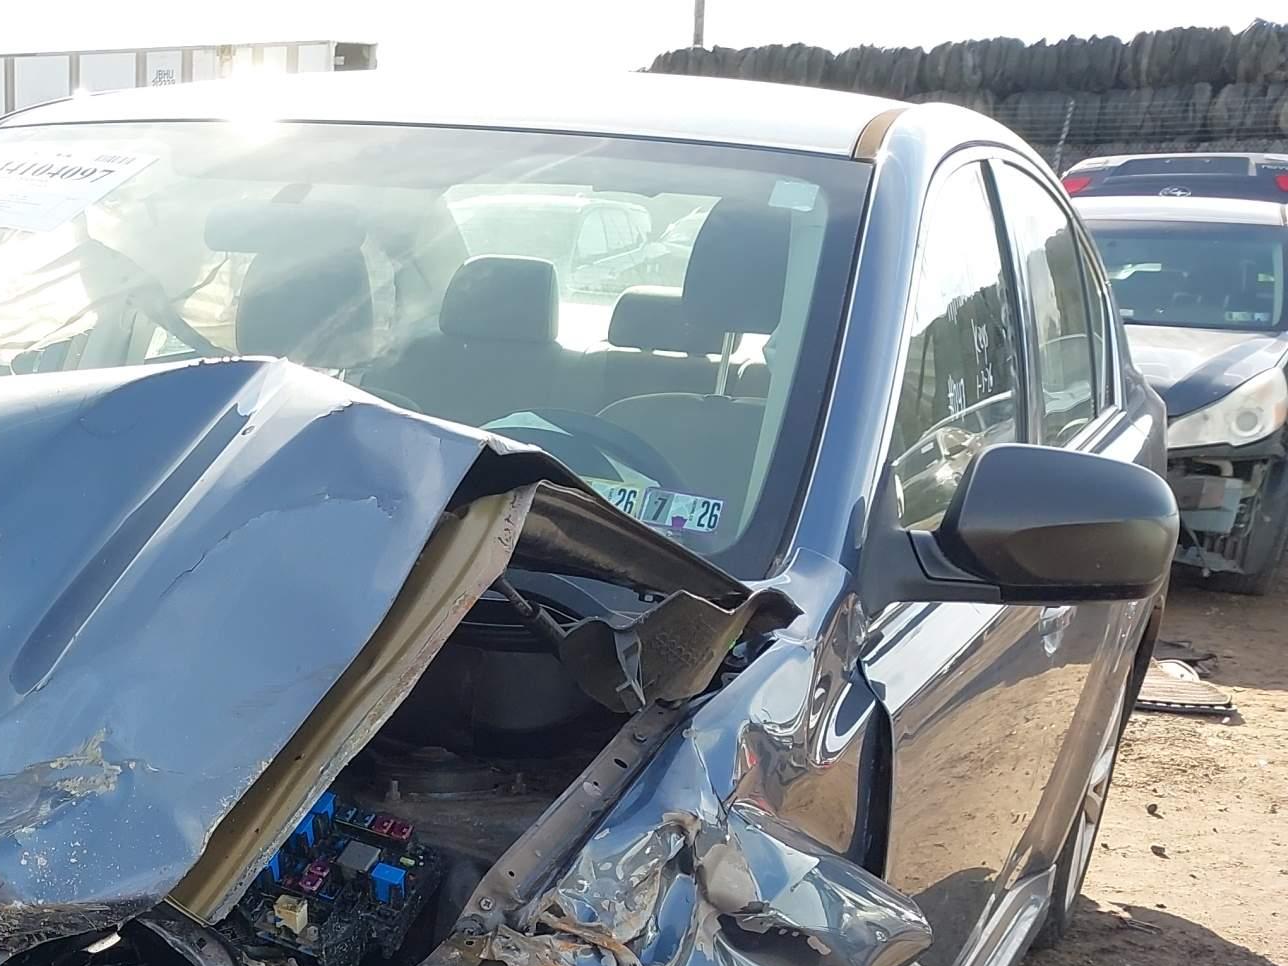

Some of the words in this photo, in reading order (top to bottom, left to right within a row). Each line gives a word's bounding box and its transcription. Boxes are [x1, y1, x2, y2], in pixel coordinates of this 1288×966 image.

[615, 488, 638, 514] 26
[654, 497, 668, 521] 7
[697, 500, 721, 529] 26
